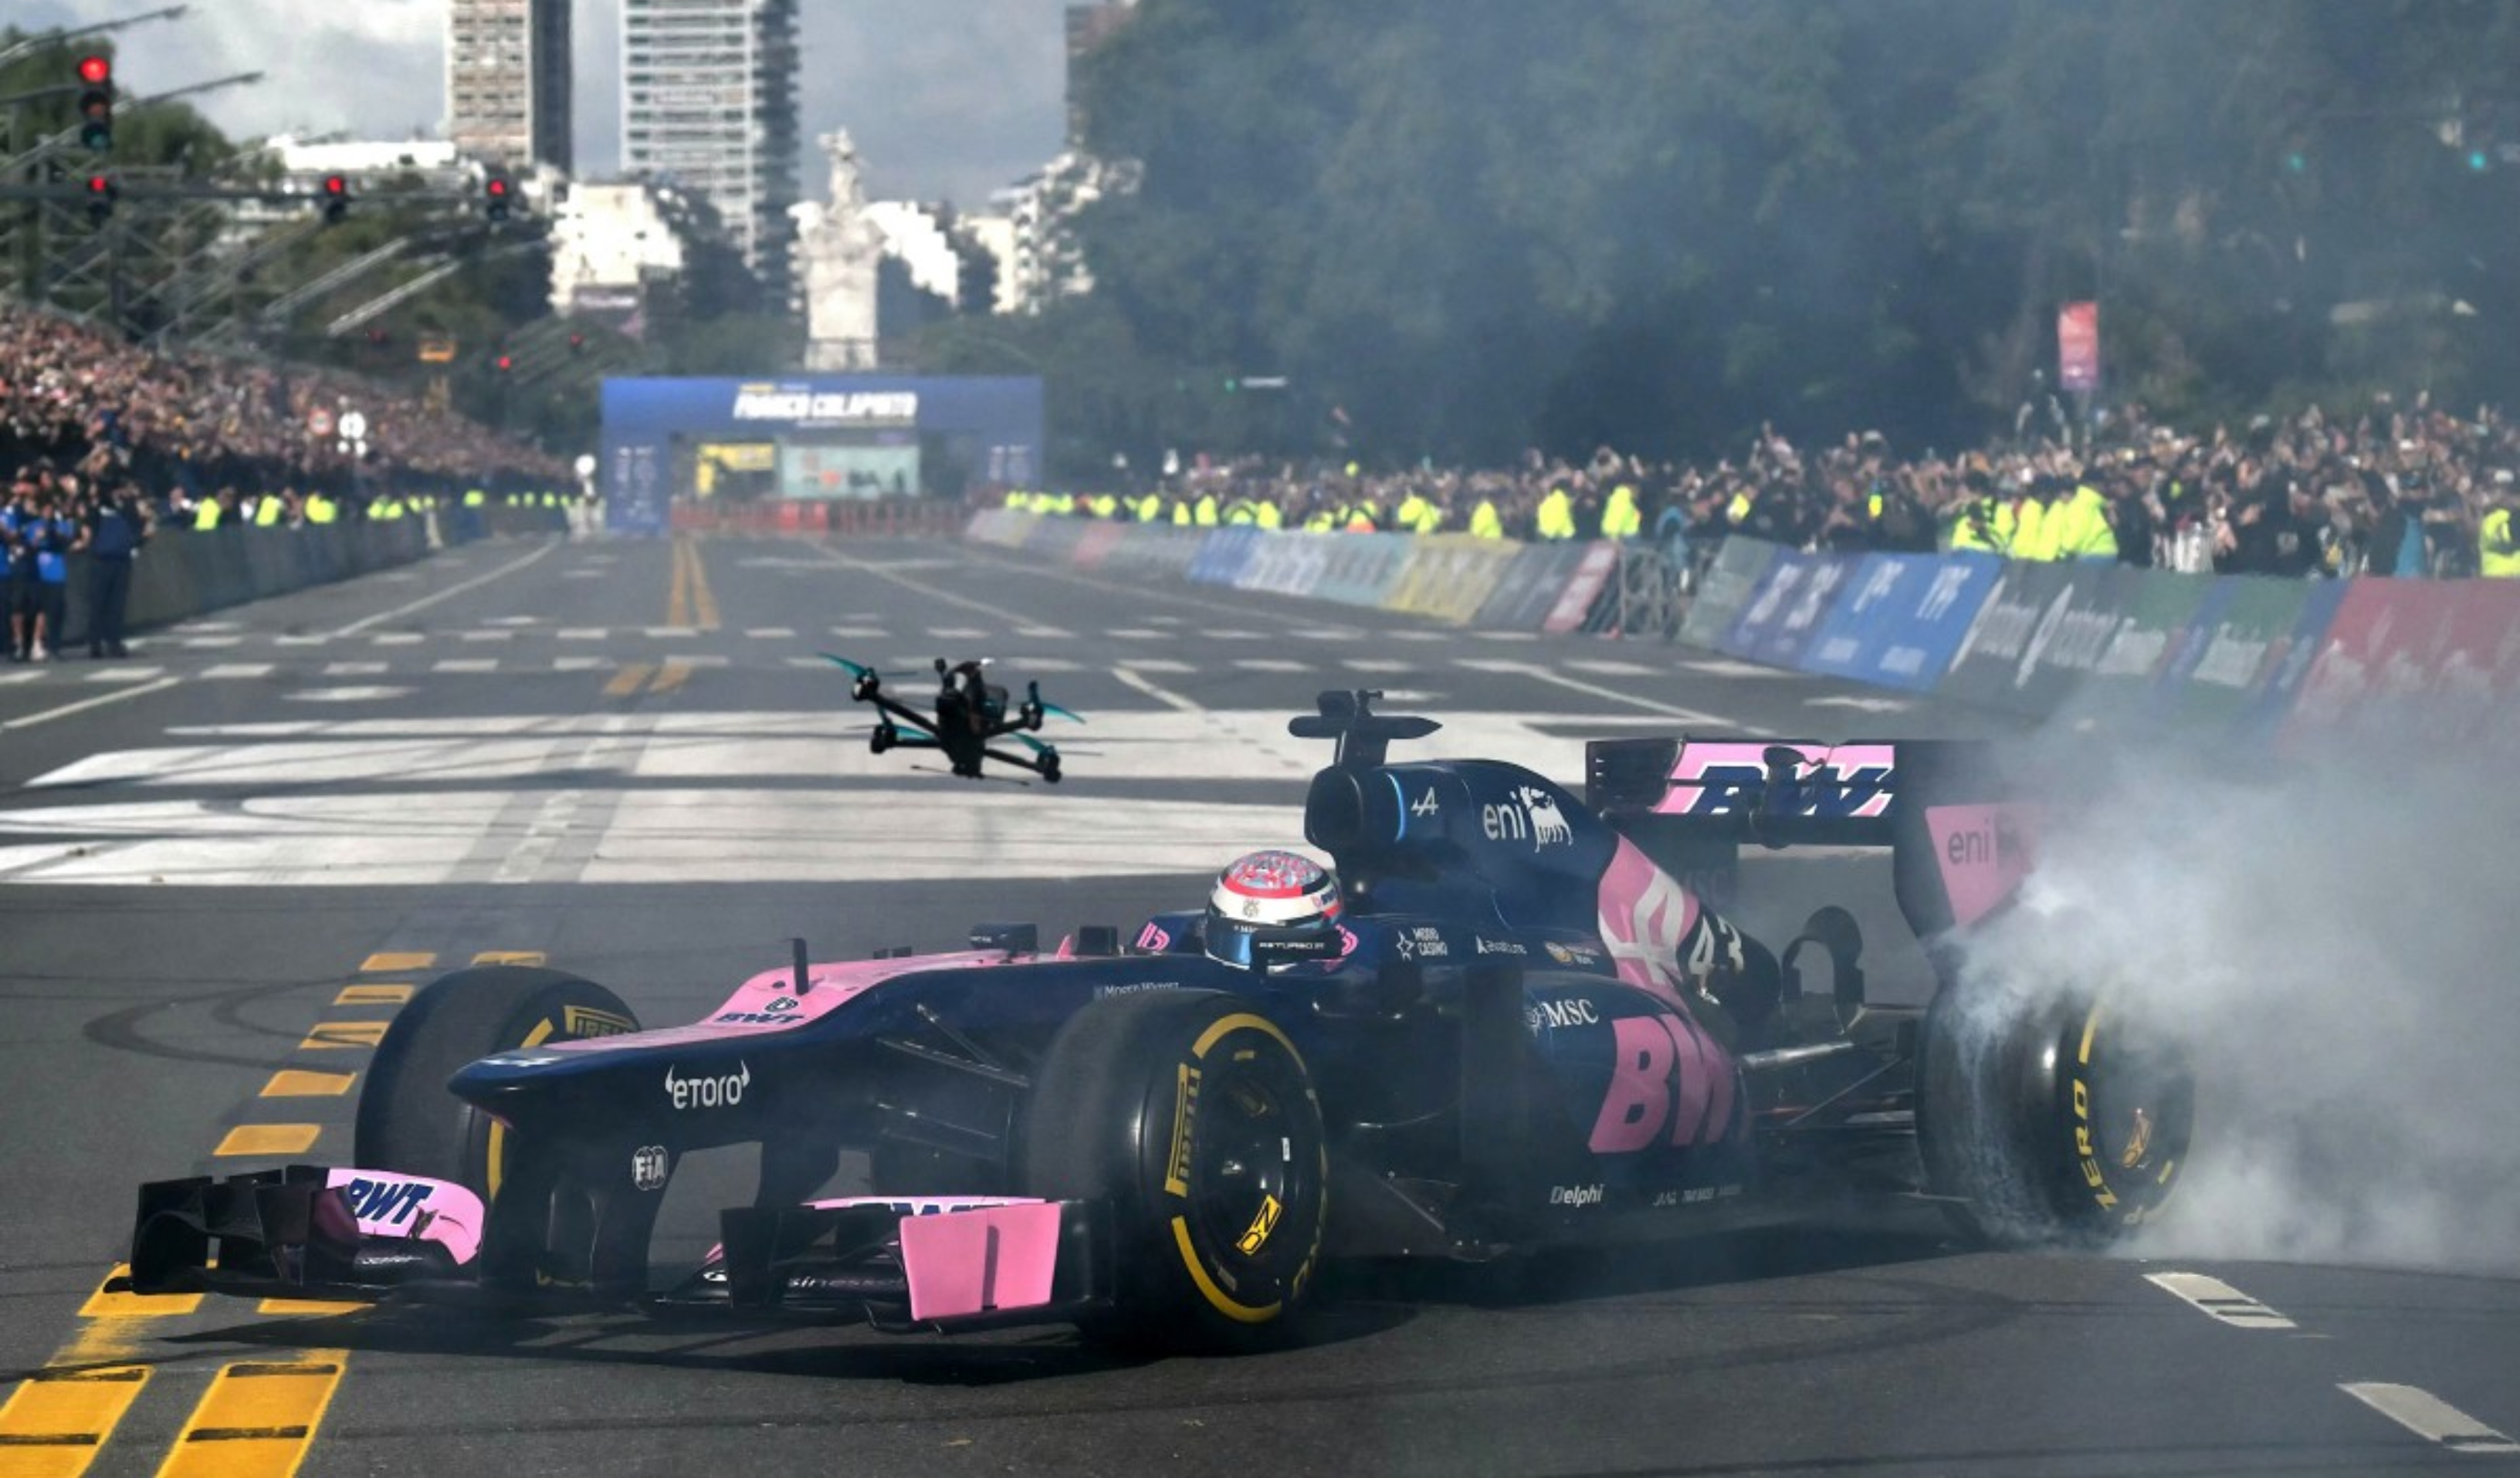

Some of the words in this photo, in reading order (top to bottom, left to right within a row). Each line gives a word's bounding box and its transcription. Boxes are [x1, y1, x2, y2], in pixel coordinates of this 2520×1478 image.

[1483, 790, 1526, 840] eni
[1948, 819, 1990, 868] eni
[713, 1013, 804, 1024] BWT
[1543, 999, 1598, 1027] MSC
[2073, 1078, 2119, 1212] ZERO
[1550, 1184, 1604, 1207] Delphi
